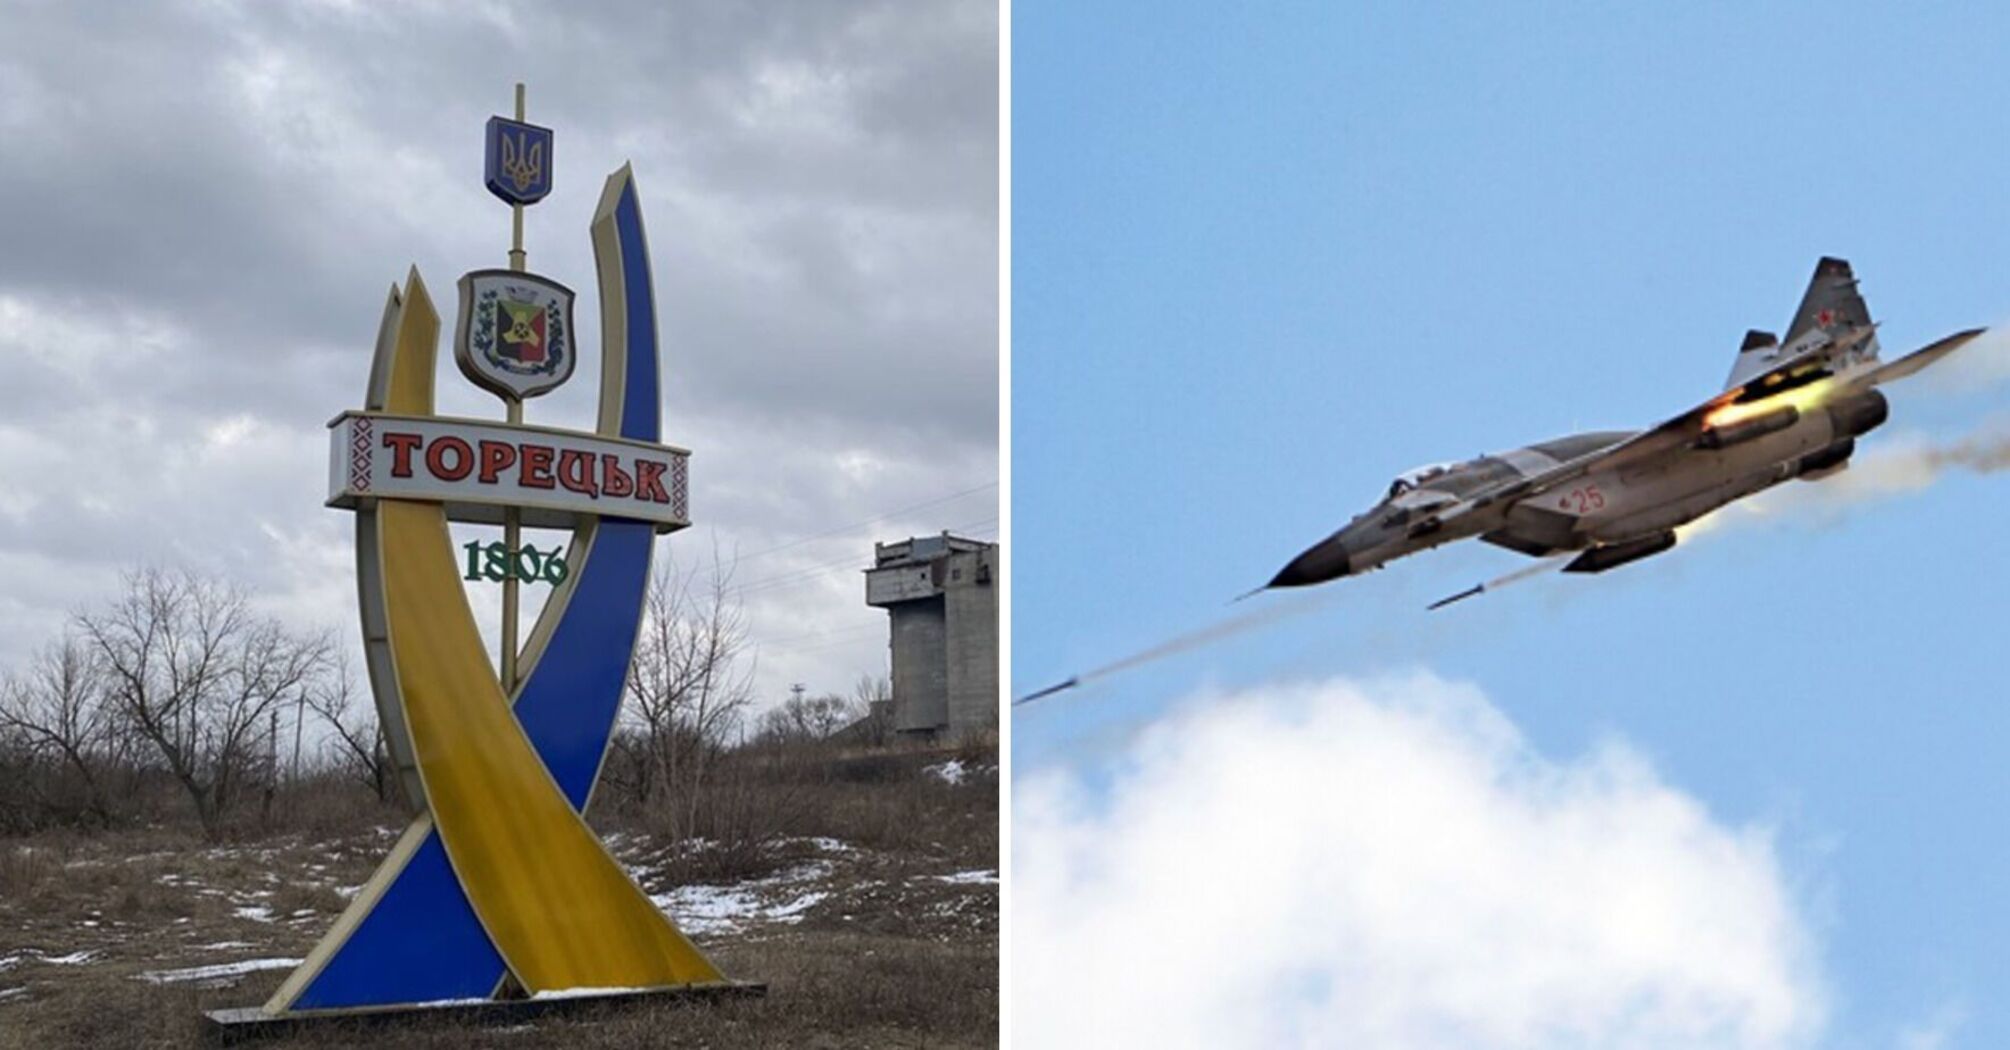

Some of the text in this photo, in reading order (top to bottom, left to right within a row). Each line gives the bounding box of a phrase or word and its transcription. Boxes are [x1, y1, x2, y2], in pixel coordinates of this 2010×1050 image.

[383, 432, 669, 502] ТОРЕЦЬК
[1571, 484, 1604, 513] 25
[463, 540, 569, 587] 1806
